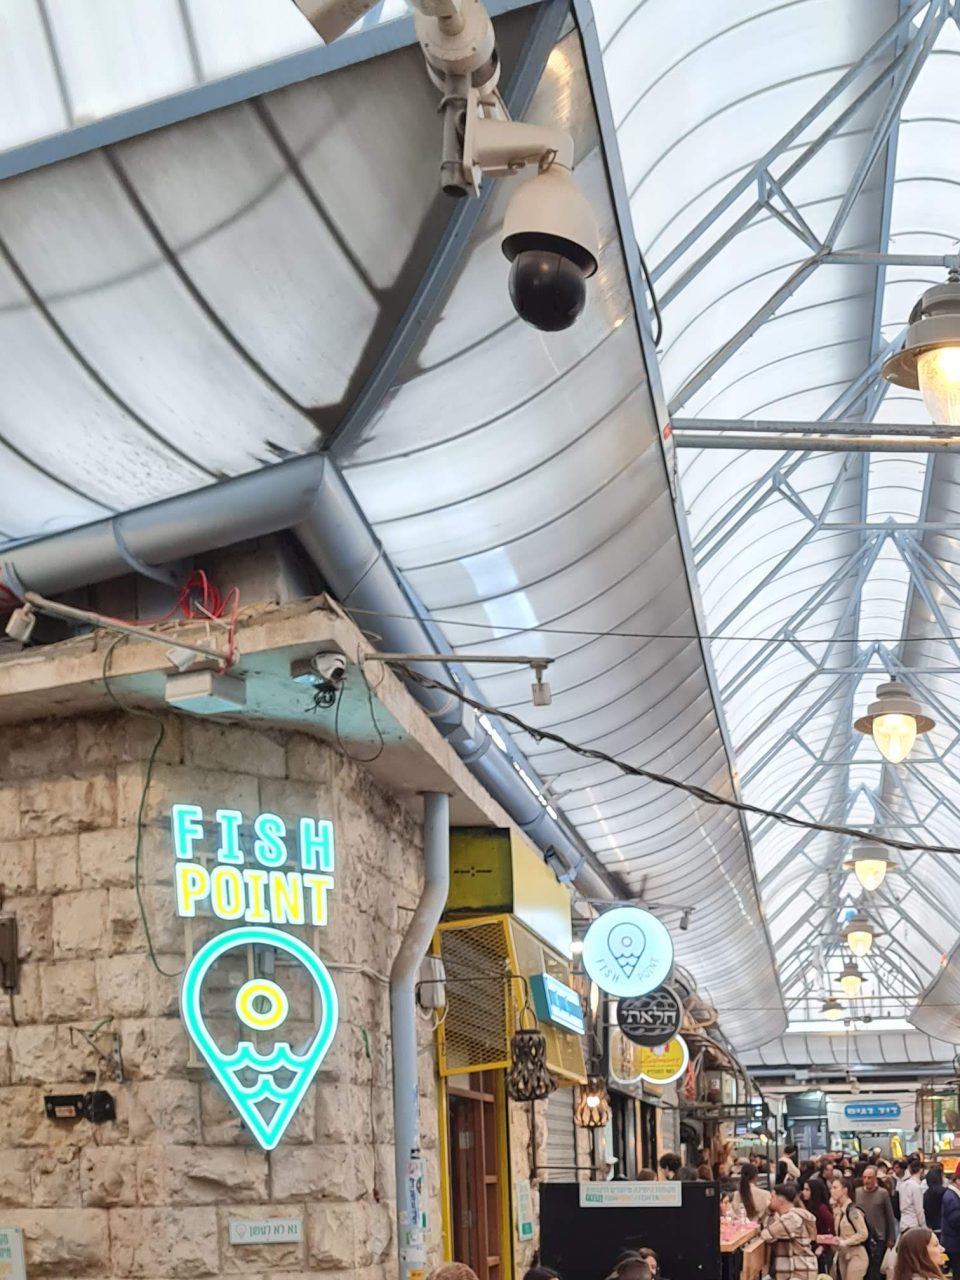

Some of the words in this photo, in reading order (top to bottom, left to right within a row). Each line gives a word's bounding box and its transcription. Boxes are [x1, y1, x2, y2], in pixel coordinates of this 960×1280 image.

[172, 804, 335, 872] FISH
[175, 862, 334, 926] POINT
[595, 958, 620, 983] FISH
[249, 1224, 271, 1237] לעשן
[273, 1224, 285, 1235] לא
